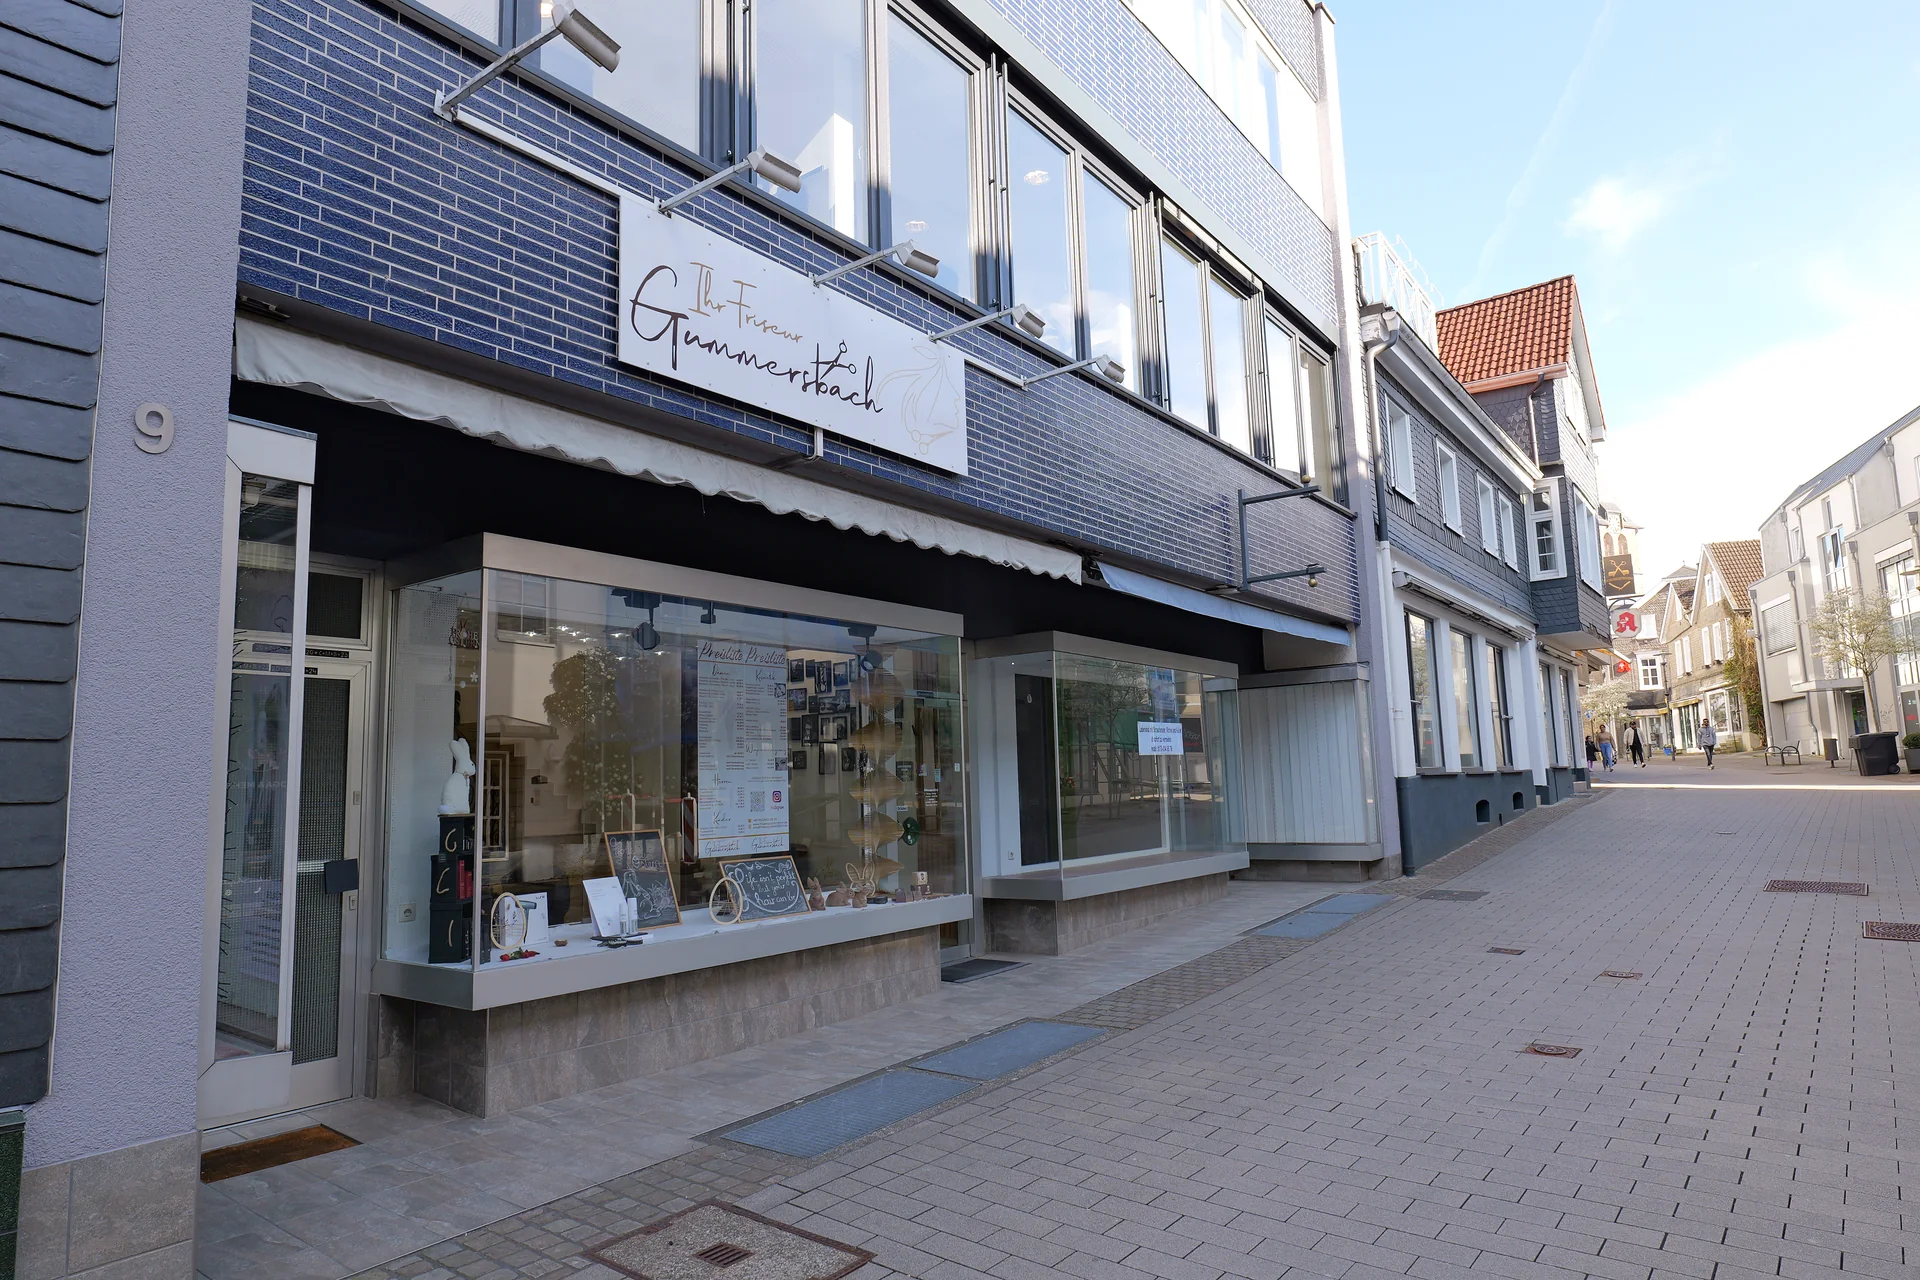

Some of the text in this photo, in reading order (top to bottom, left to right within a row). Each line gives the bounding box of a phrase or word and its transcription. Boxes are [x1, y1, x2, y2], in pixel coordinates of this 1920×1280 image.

[688, 262, 803, 344] Ihr Friseur
[629, 264, 884, 414] Gummersbach
[133, 403, 174, 454] 9
[699, 642, 743, 660] Preisliste
[745, 646, 786, 665] Preisliste
[754, 892, 775, 906] hair
[776, 895, 787, 903] can
[771, 884, 785, 896] your
